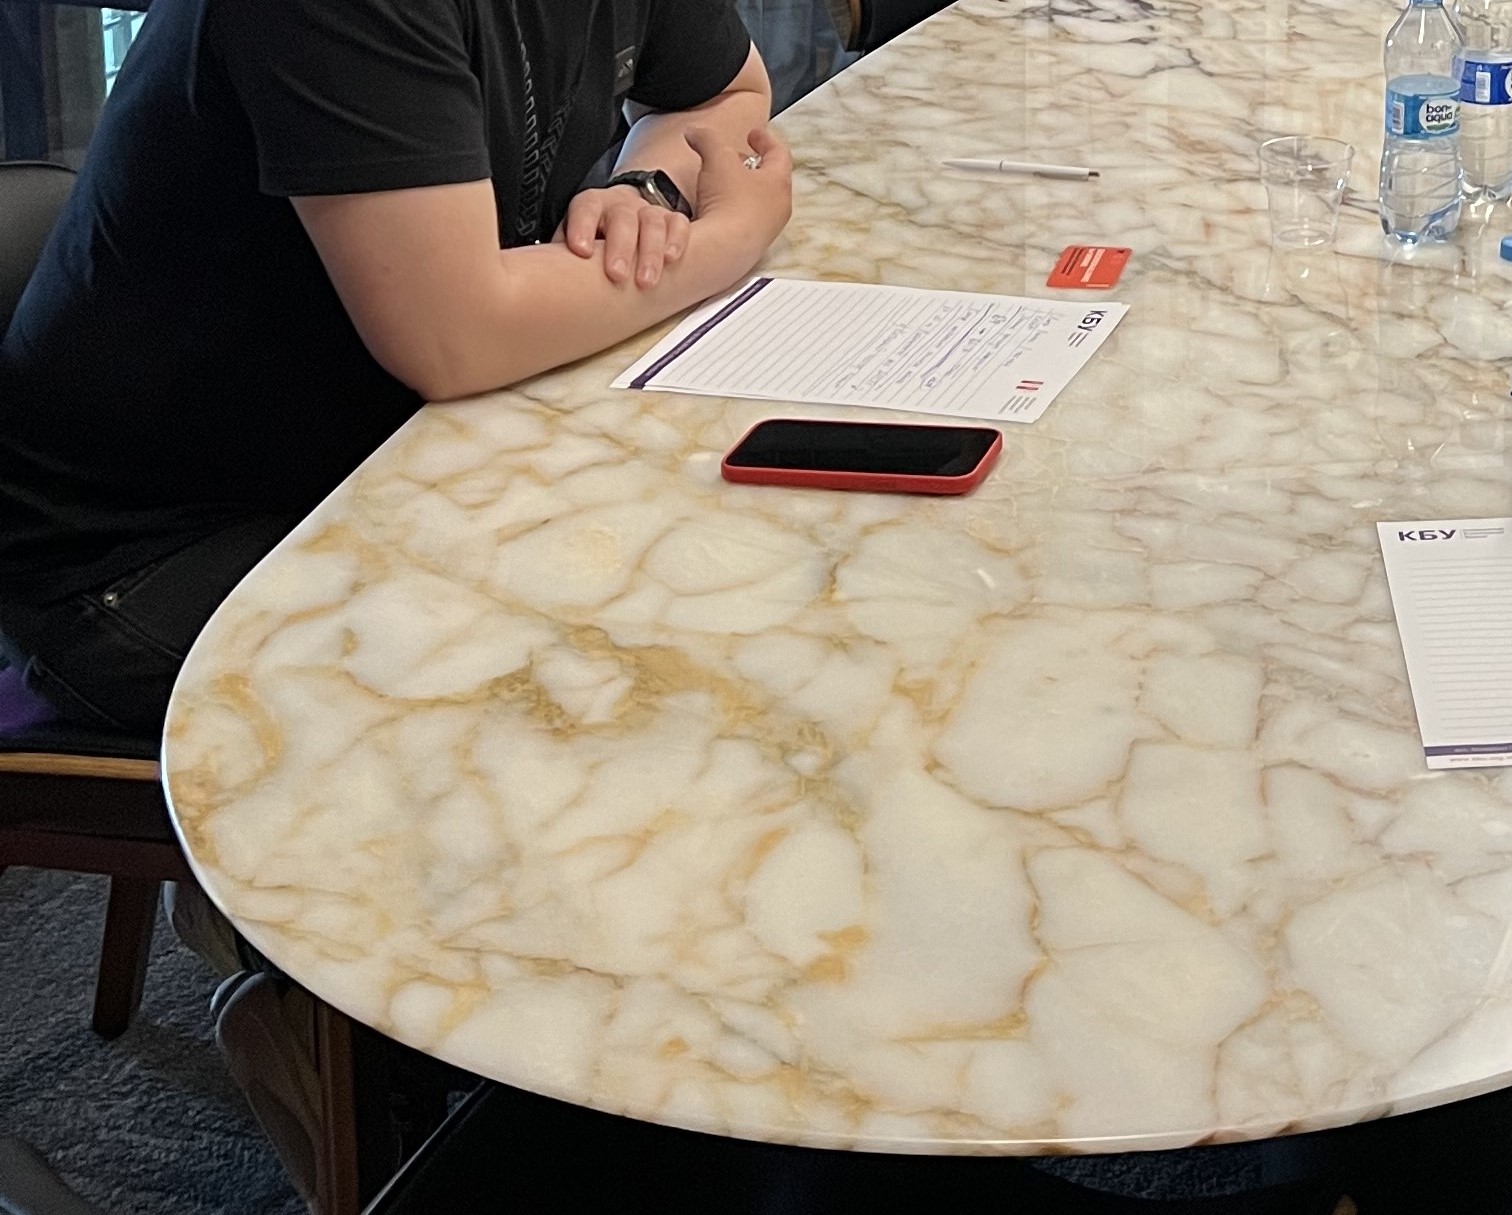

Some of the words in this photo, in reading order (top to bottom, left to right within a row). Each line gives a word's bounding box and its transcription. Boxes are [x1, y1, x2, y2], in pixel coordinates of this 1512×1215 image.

[1425, 111, 1453, 123] aqua
[1077, 309, 1108, 332] КБУ
[1398, 528, 1457, 542] КБУ
